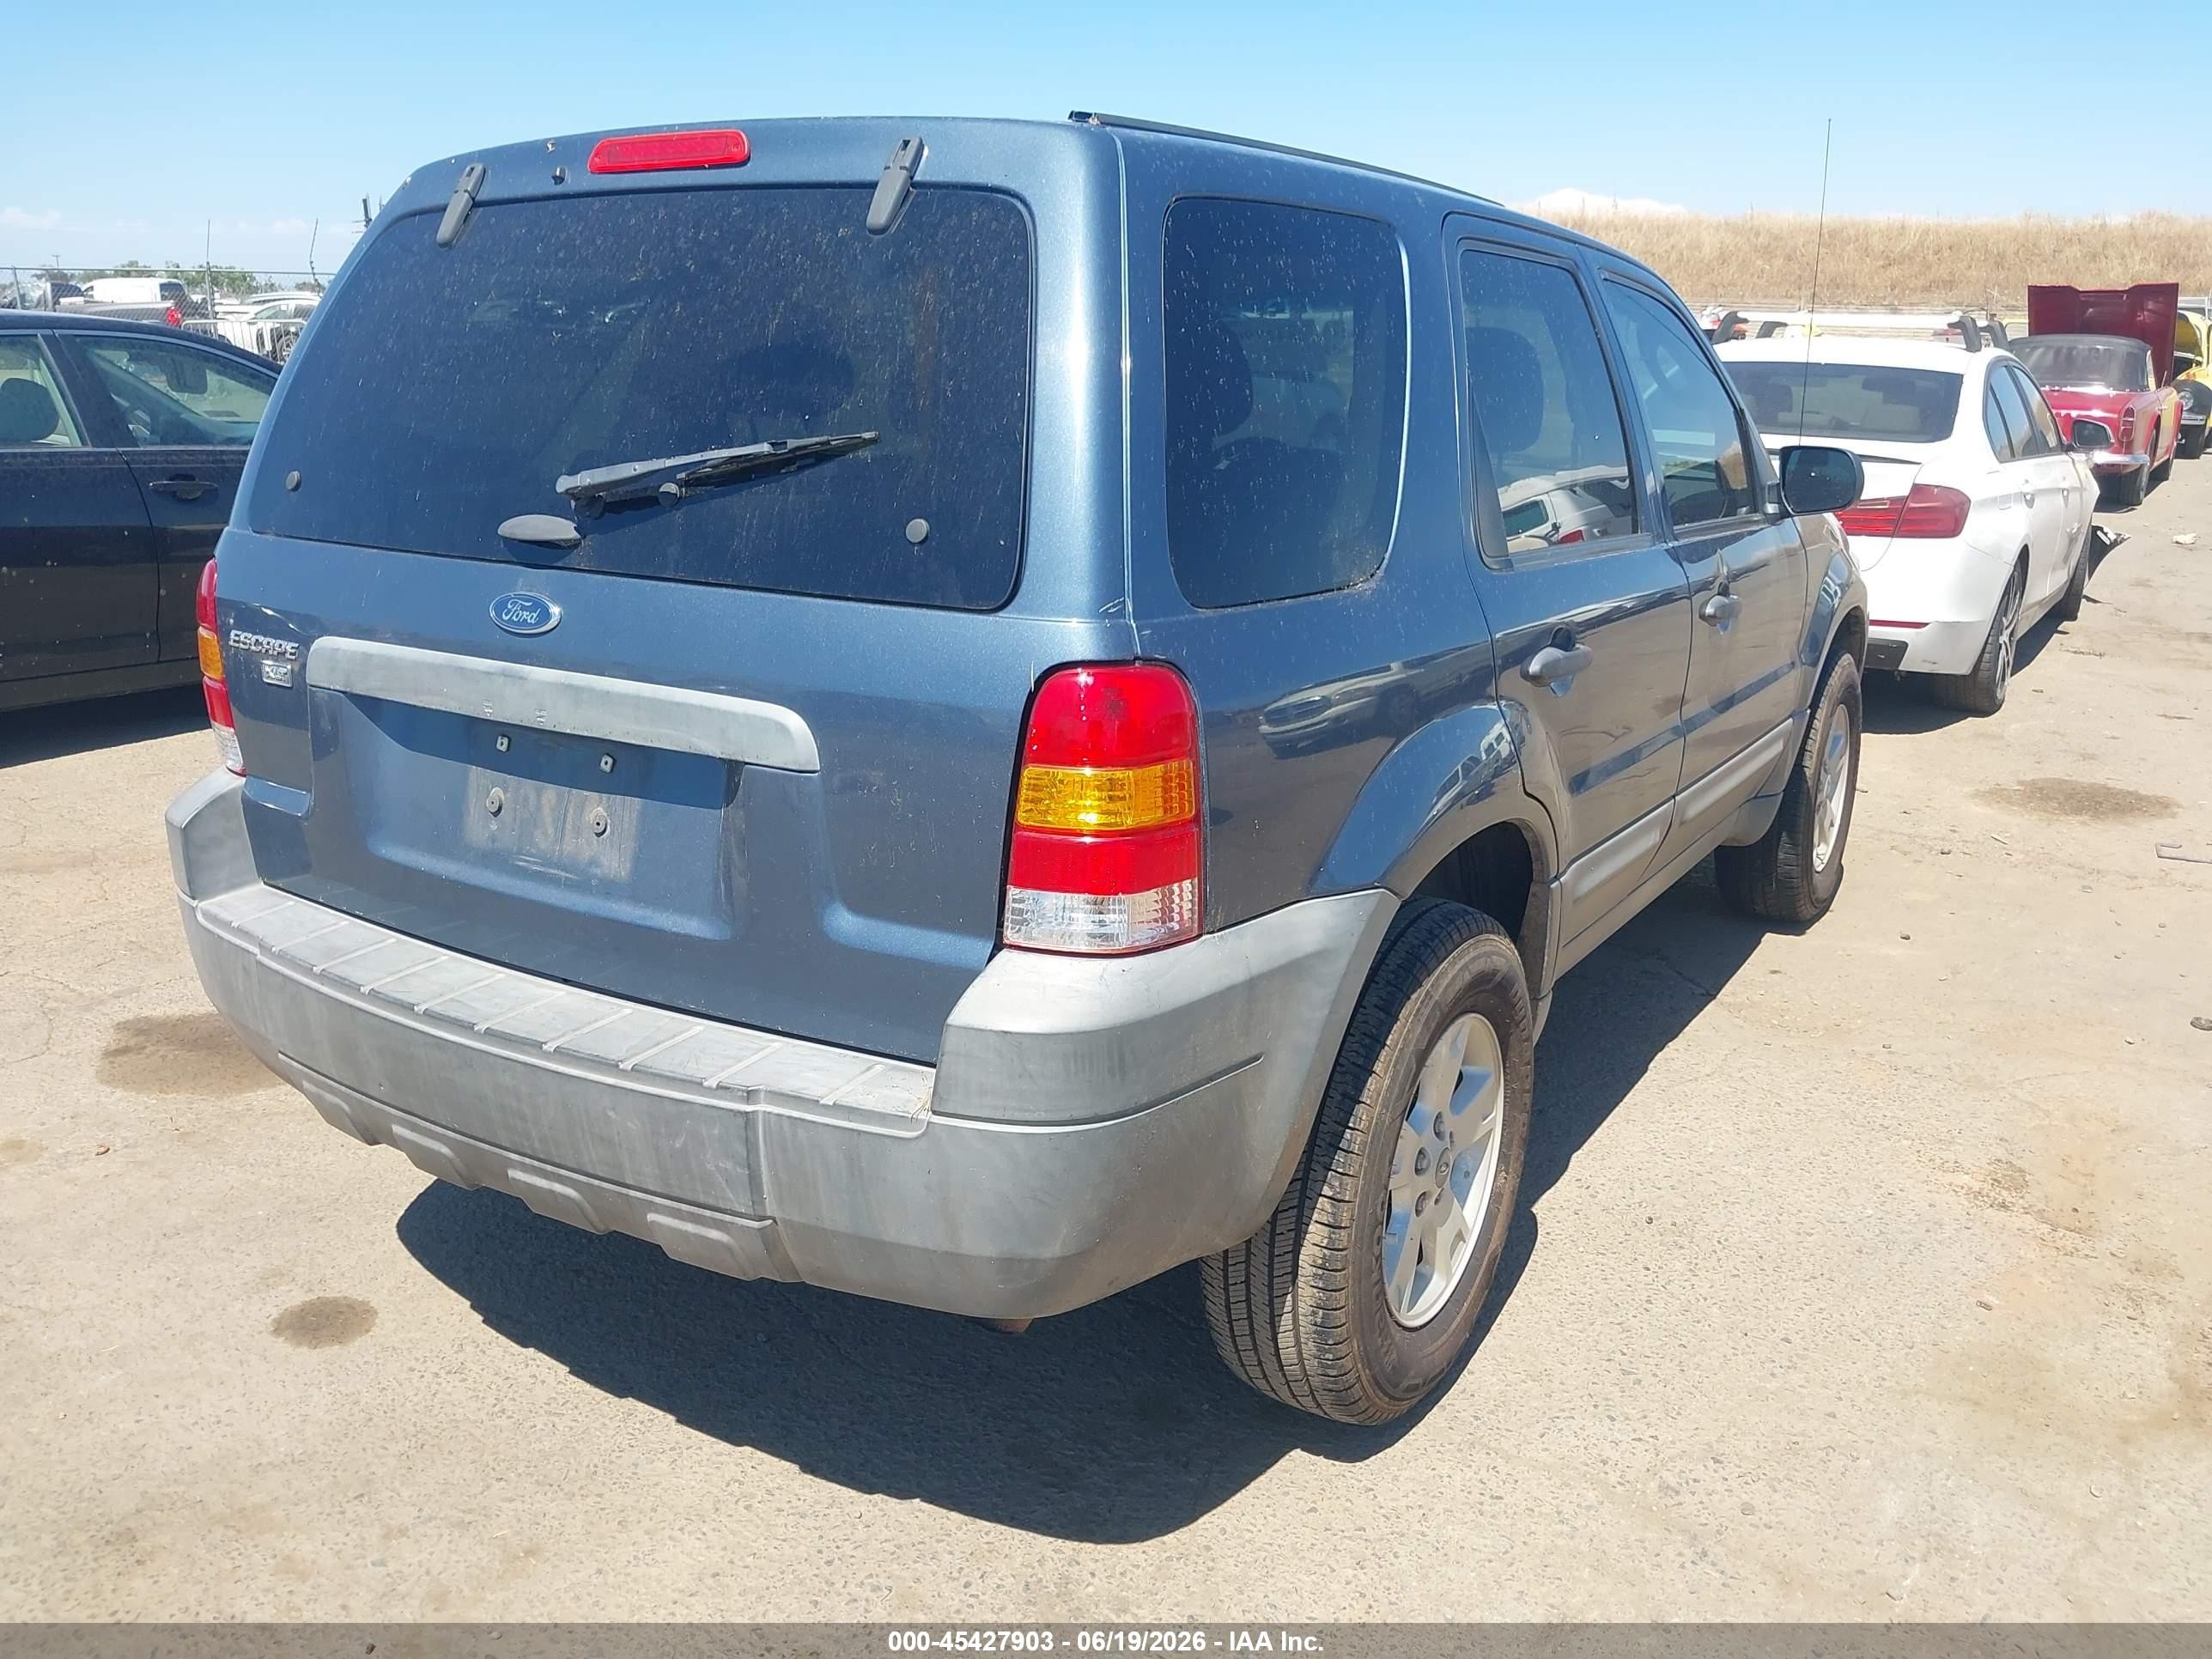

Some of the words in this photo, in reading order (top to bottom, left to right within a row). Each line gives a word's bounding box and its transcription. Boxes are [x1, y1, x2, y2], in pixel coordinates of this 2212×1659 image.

[502, 599, 541, 623] Ford
[228, 629, 300, 660] ESCAPE
[264, 665, 289, 682] XLT
